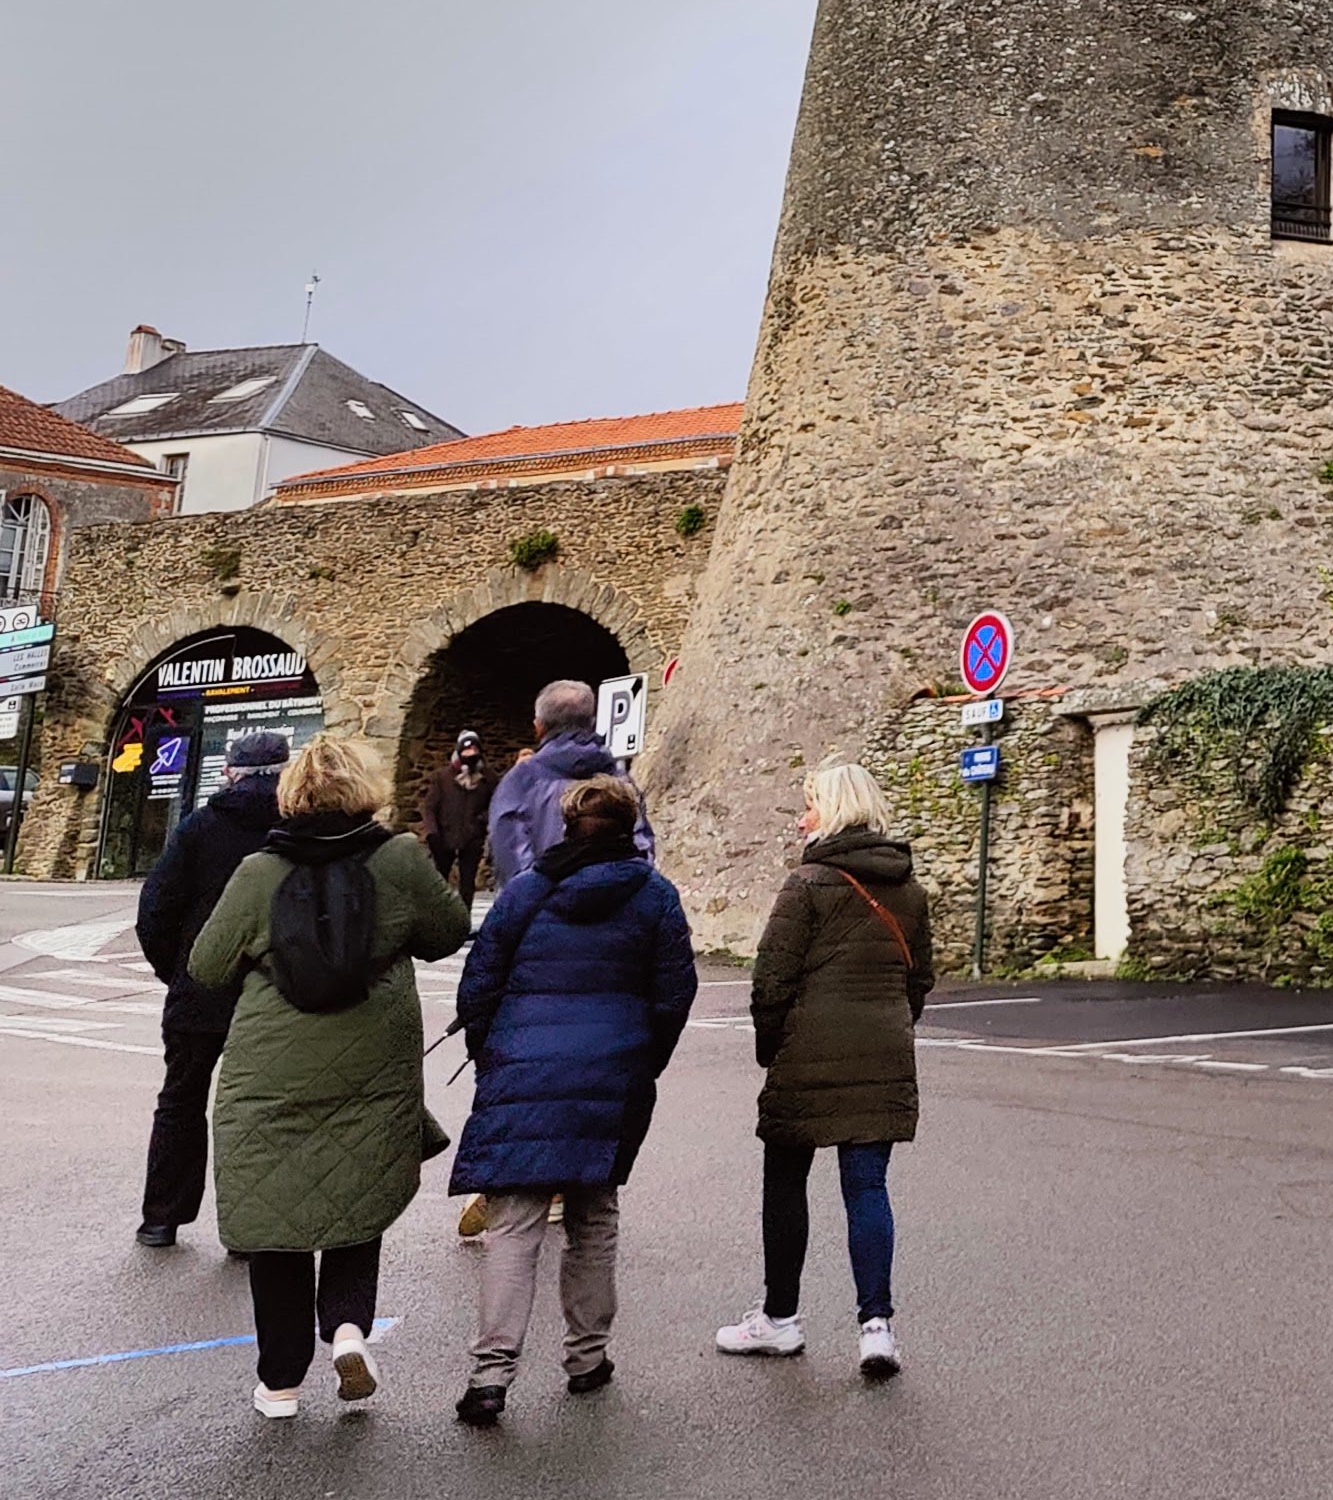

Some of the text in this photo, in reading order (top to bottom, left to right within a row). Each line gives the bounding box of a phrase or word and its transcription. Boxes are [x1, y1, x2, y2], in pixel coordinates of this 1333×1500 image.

[158, 652, 307, 687] VALENTIN BROSSAUD
[609, 690, 632, 747] P
